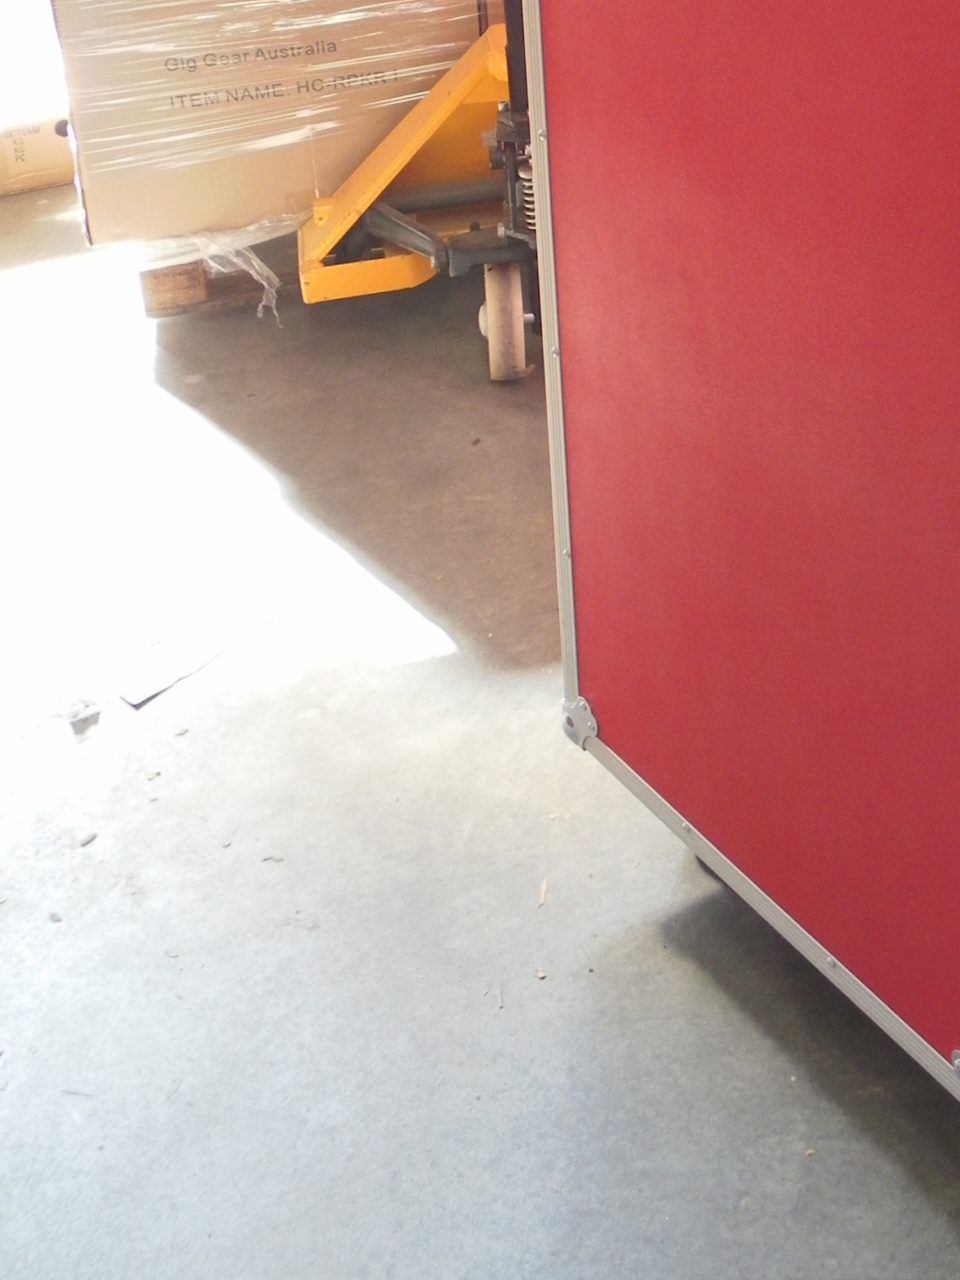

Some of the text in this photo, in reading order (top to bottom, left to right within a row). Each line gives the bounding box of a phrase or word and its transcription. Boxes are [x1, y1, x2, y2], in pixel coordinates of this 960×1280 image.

[164, 39, 338, 73] Gig Gear Australia
[169, 90, 221, 110] ITEM
